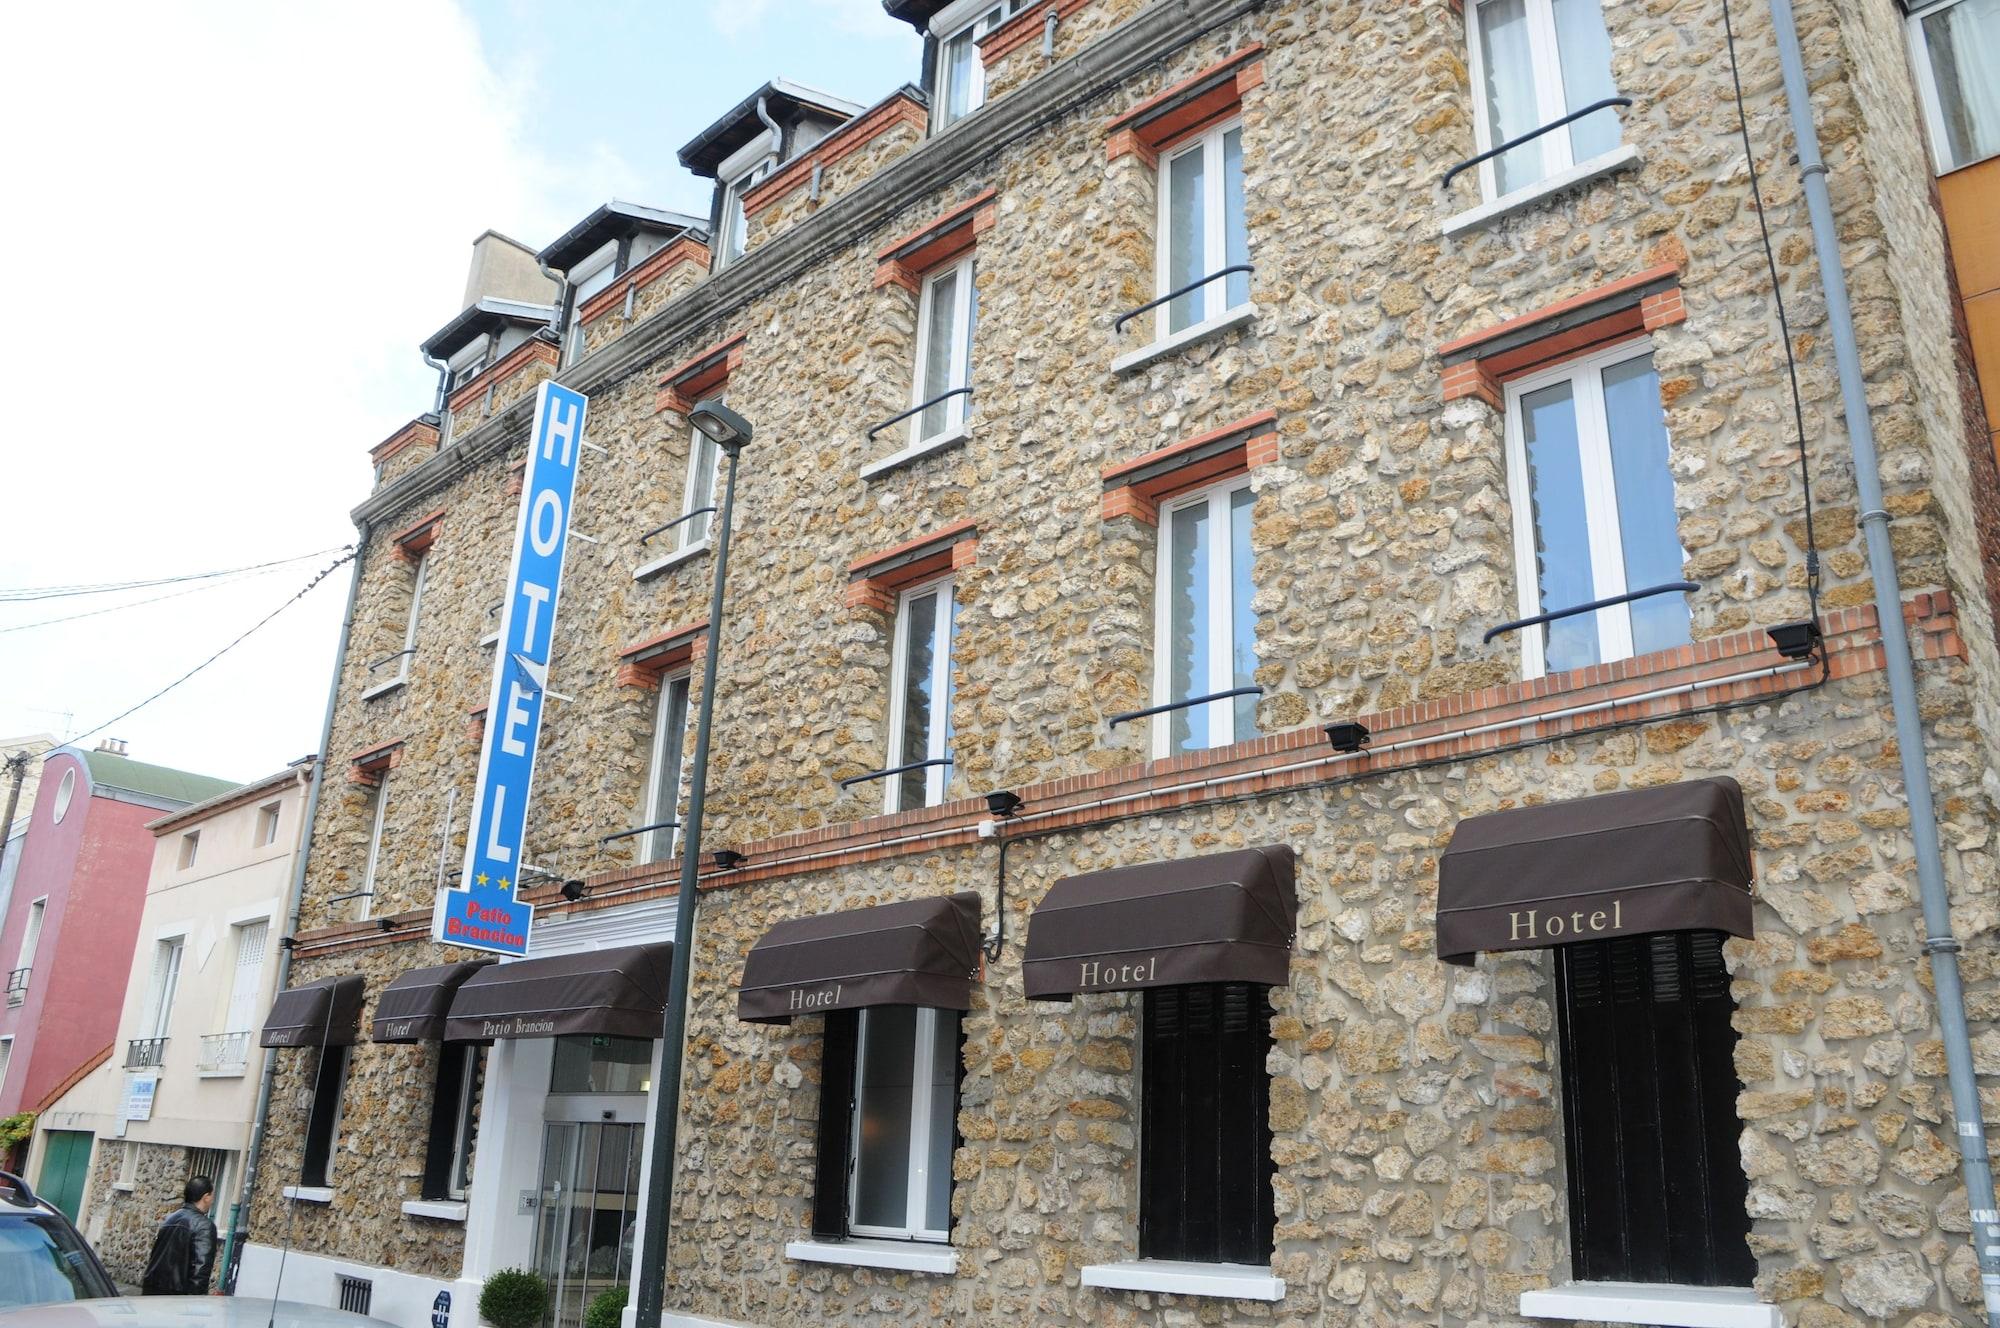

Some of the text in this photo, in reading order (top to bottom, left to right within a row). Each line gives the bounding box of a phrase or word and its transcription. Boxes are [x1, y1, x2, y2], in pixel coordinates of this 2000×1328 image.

[486, 396, 578, 863] HOTEL
[467, 901, 511, 925] Patio
[1508, 899, 1623, 940] Hotel
[448, 917, 523, 946] Brancion
[1079, 957, 1156, 987] Hotel
[788, 984, 842, 1010] Hotel
[268, 1031, 290, 1044] Hotel
[386, 1022, 411, 1037] Hotel
[481, 1018, 554, 1036] Patio Brancion
